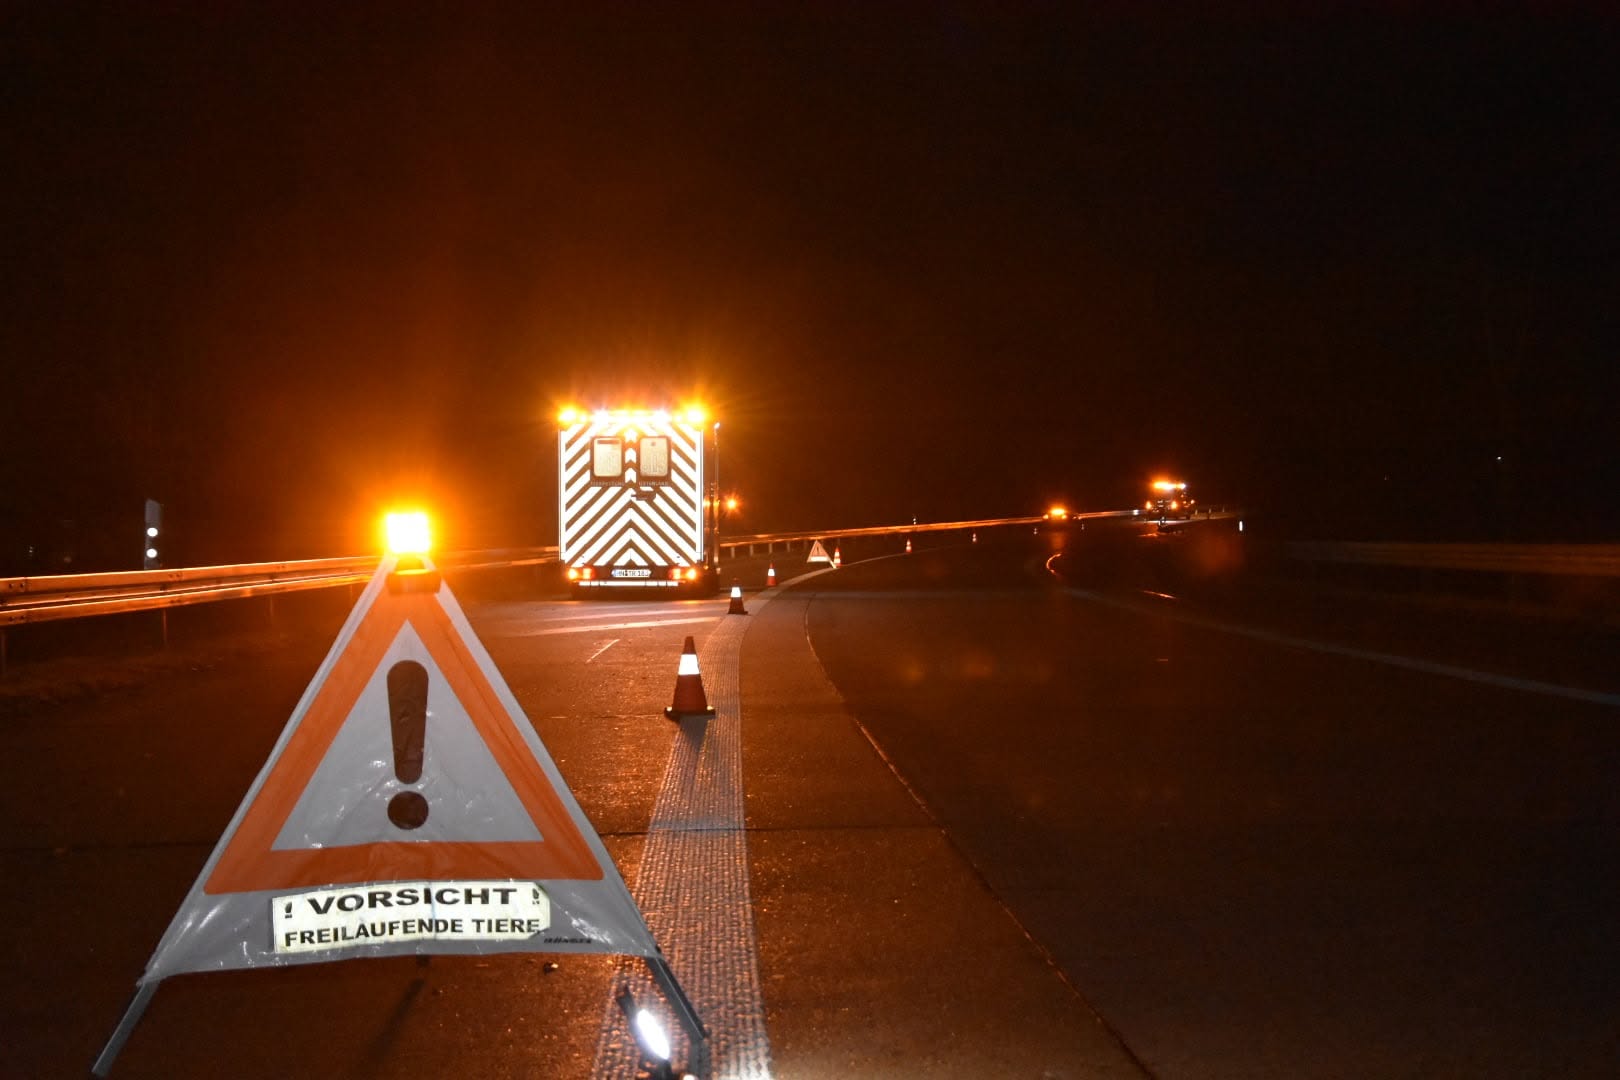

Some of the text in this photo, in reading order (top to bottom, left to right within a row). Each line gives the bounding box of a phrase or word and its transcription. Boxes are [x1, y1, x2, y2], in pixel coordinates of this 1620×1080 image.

[307, 888, 517, 915] VORSICHT
[285, 918, 541, 947] FREILAUFENDE TIERE
